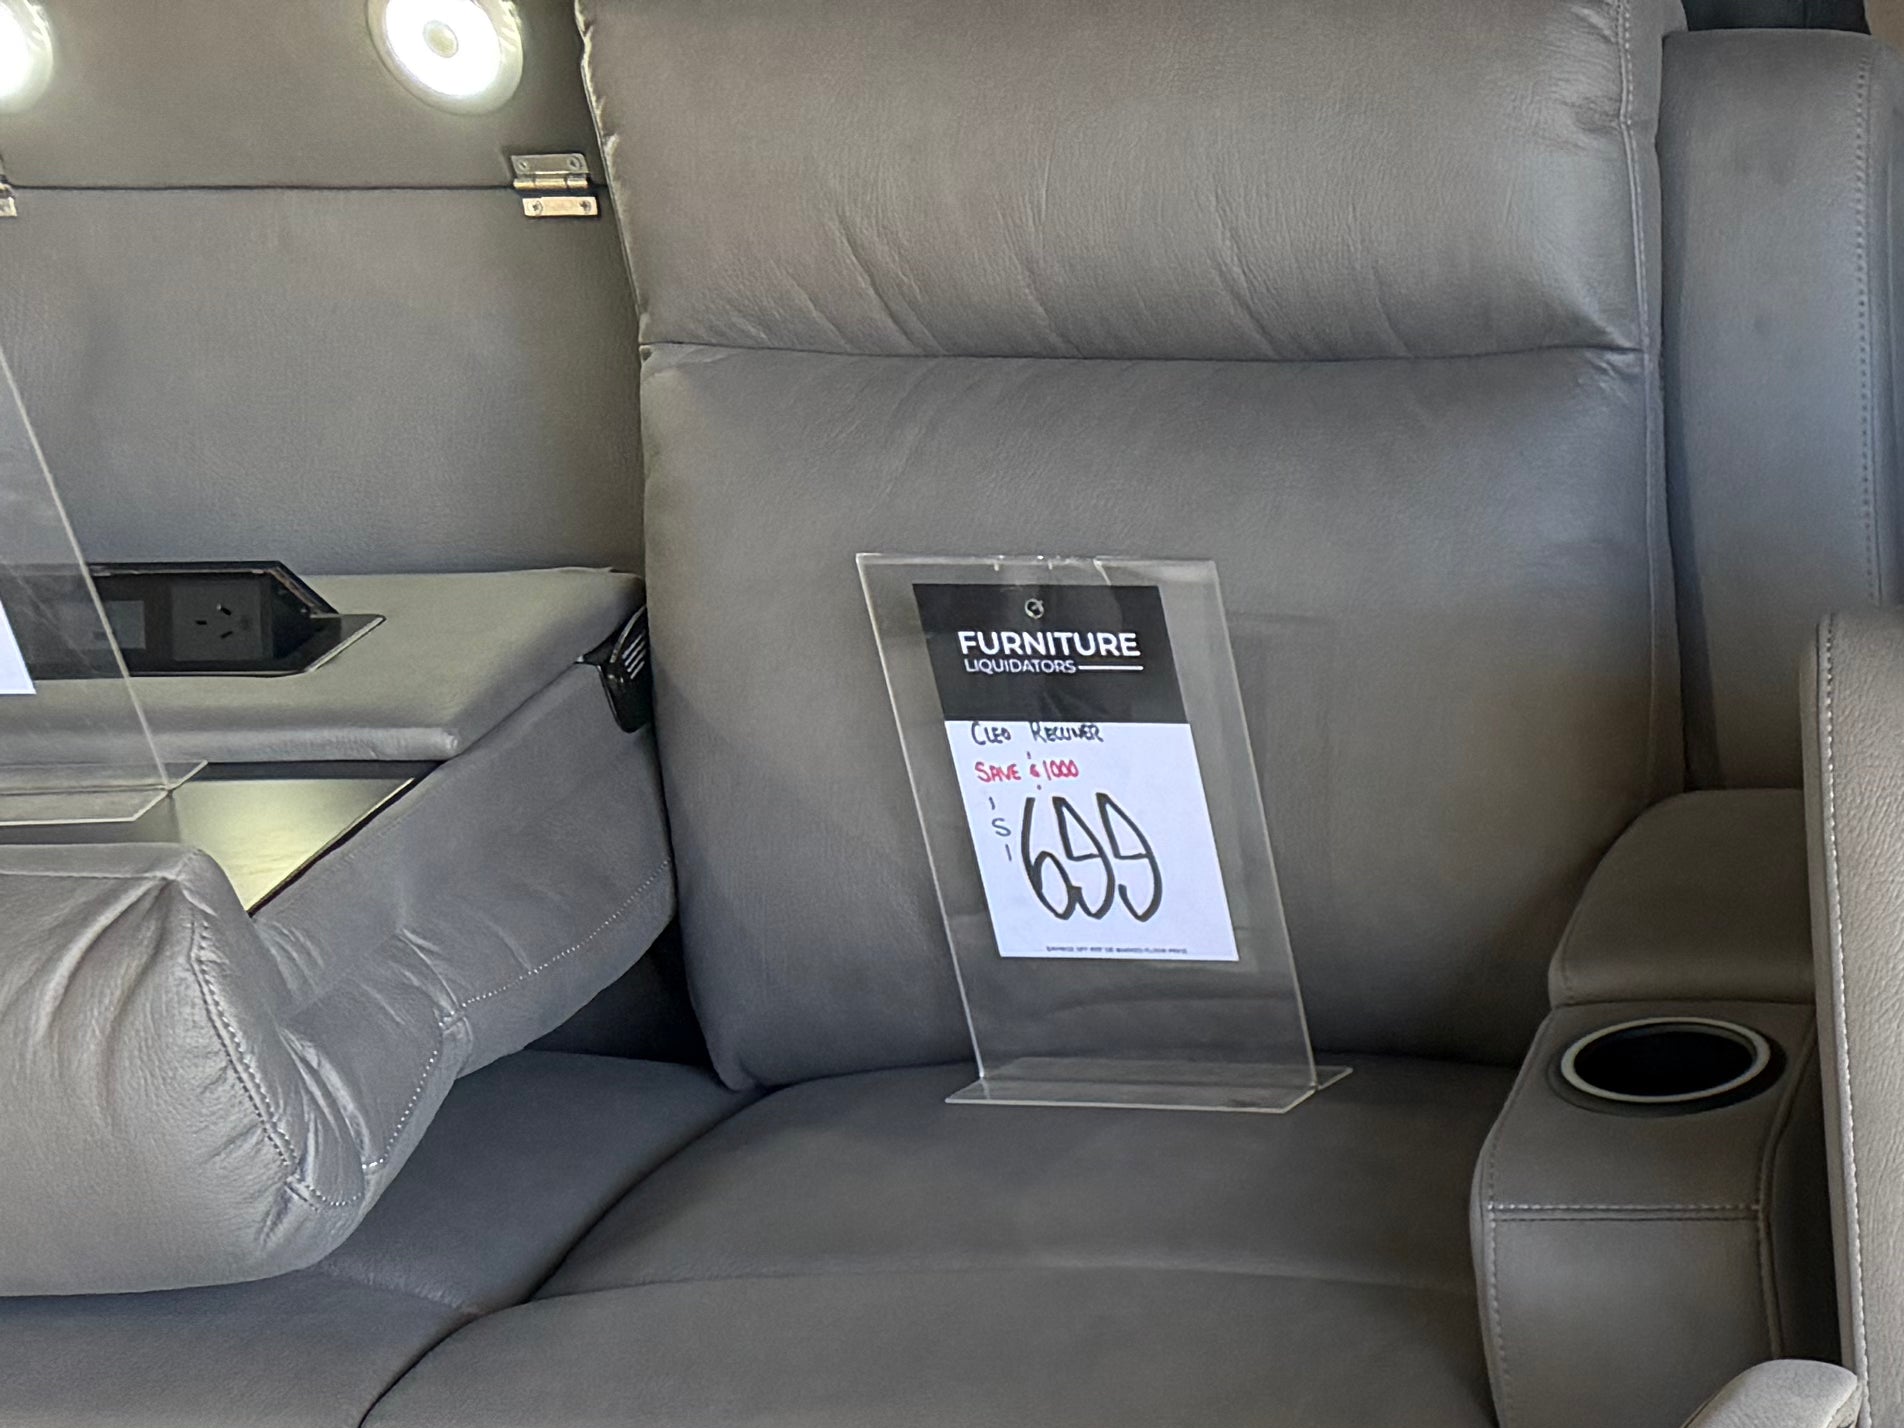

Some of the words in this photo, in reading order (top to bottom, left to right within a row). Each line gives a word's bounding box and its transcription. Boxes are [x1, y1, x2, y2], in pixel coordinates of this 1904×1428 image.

[957, 631, 1141, 657] FURNITURE
[964, 658, 1077, 674] LIQUIDATORS
[974, 761, 1022, 783] SAVE
